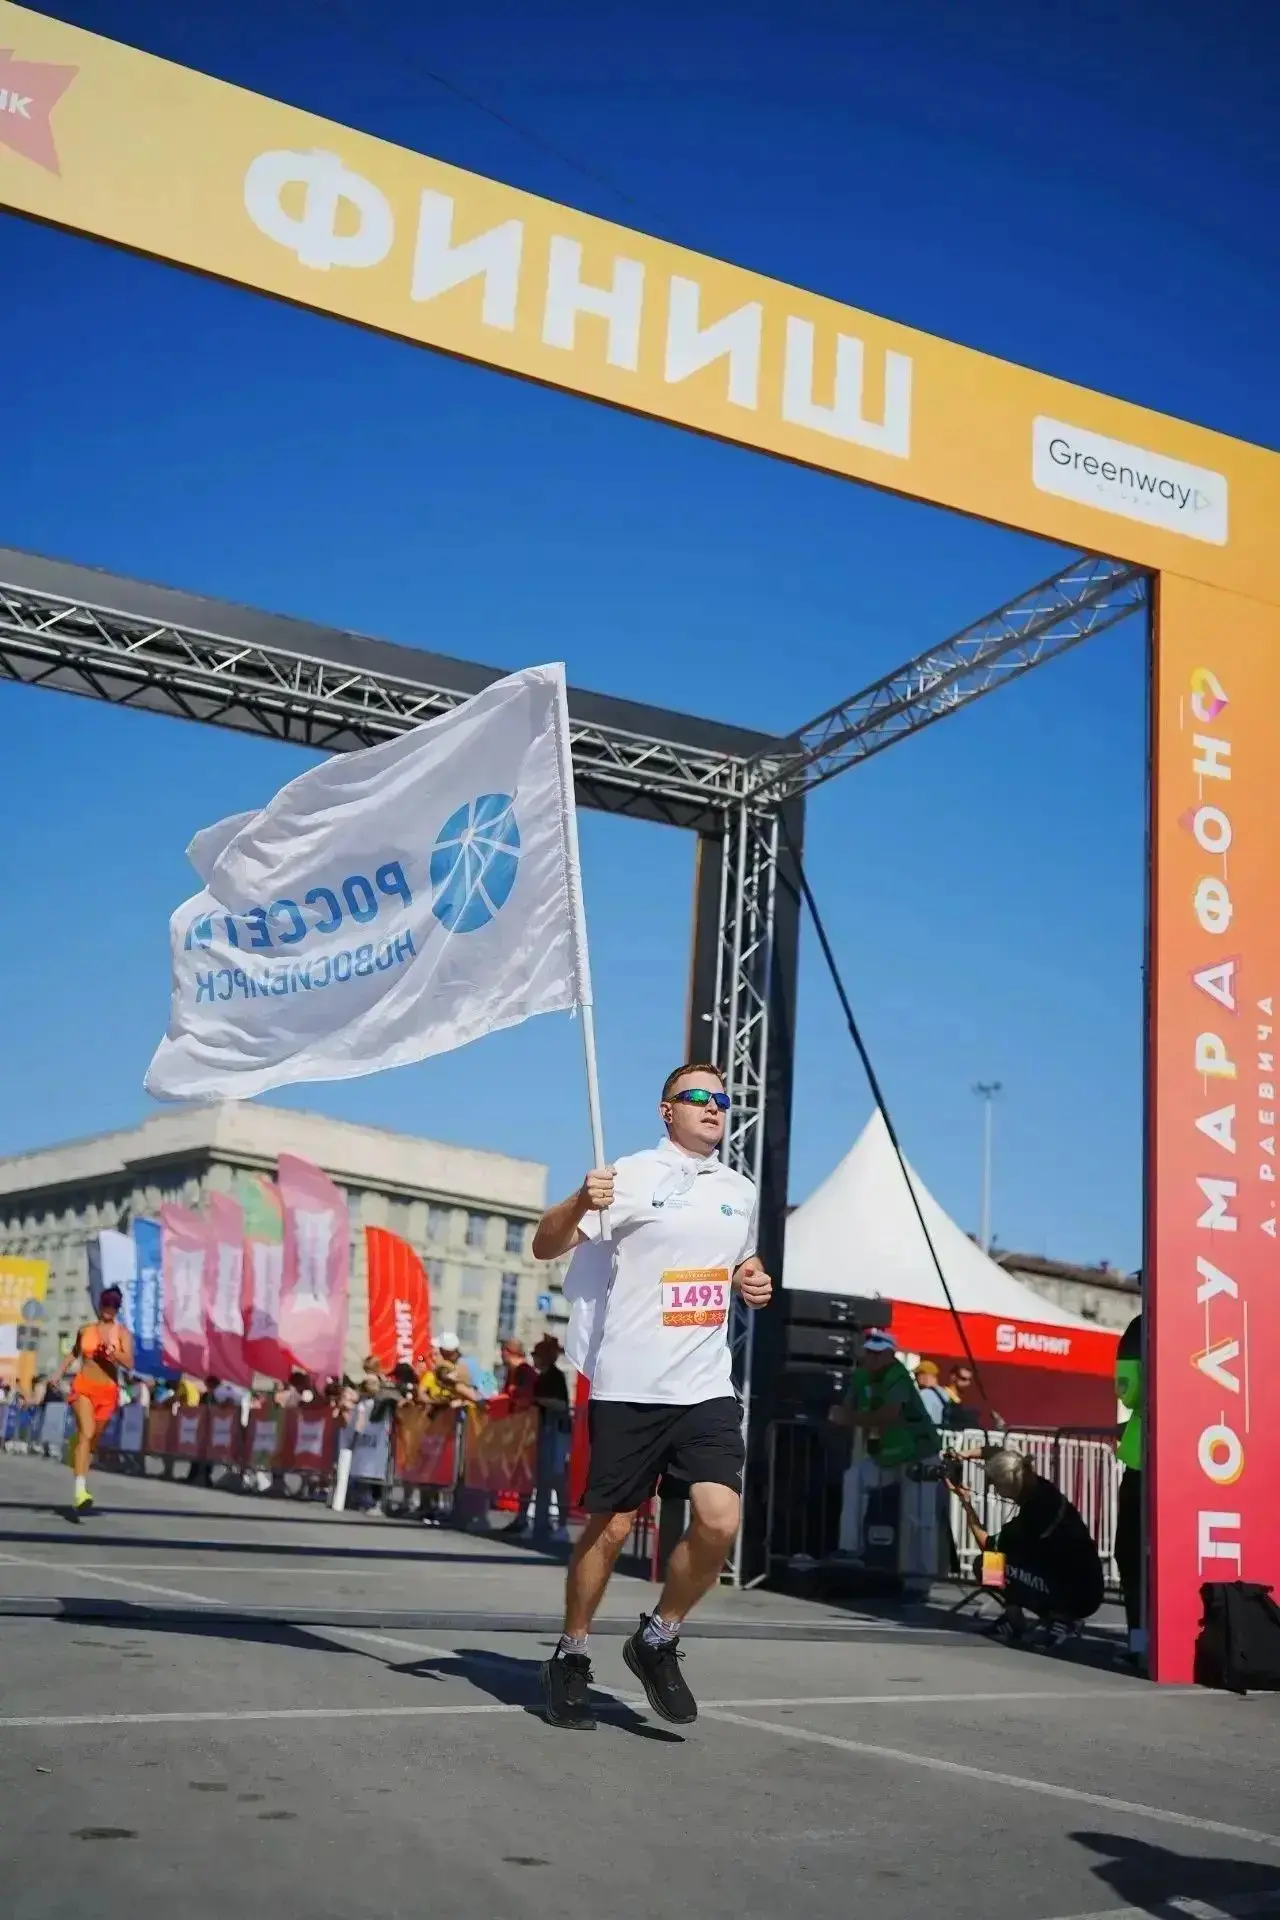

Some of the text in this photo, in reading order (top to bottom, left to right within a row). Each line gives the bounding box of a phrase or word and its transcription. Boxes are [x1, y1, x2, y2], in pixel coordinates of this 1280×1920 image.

[244, 148, 912, 459] ФИНИШ
[1049, 439, 1191, 509] Greenway
[1192, 734, 1243, 1576] ПОЛУМАРАФОН
[1257, 996, 1276, 1182] РАЕВИЧА
[672, 1285, 724, 1308] 1493
